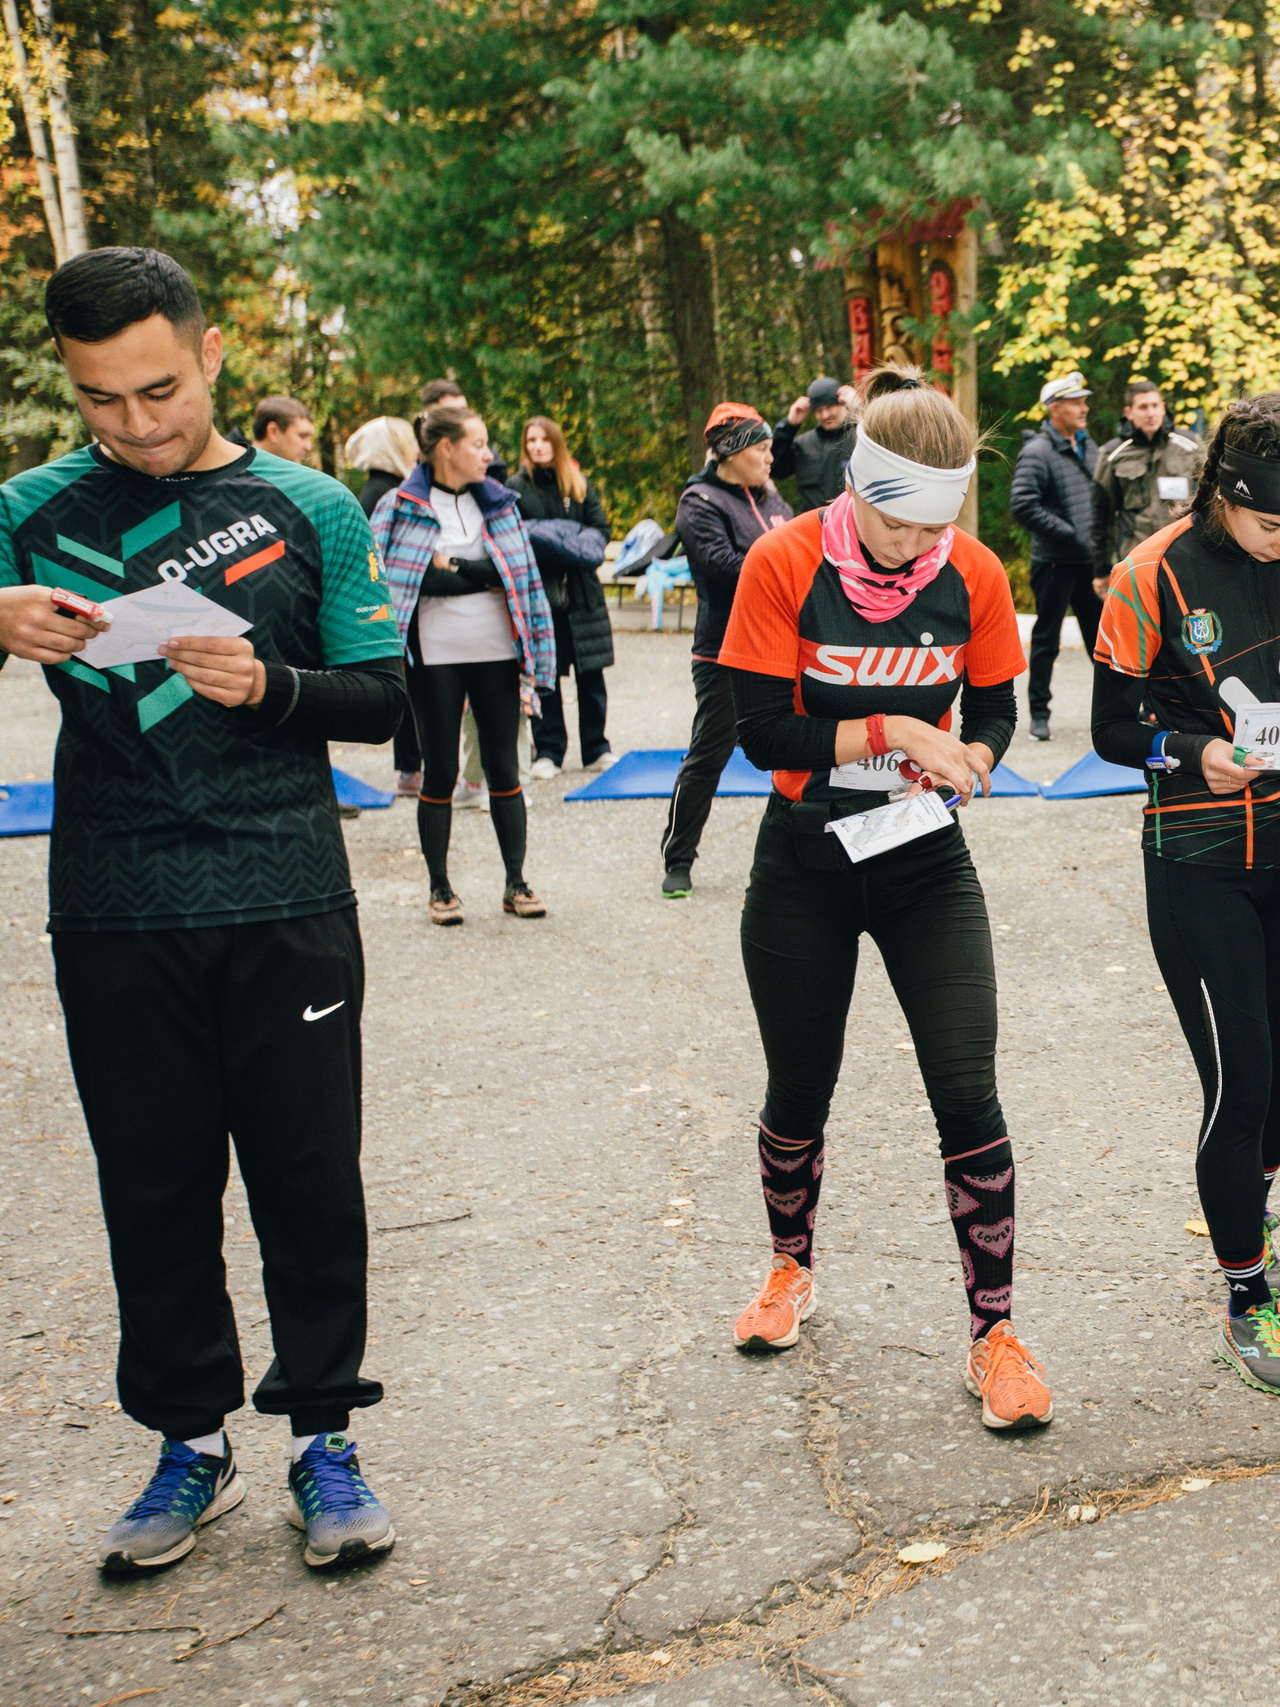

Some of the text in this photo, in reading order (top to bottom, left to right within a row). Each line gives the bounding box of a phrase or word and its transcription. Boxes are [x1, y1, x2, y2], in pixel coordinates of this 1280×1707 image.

[157, 514, 278, 582] O-UGRA
[857, 752, 900, 772] 406
[976, 1225, 1011, 1243] LOVER
